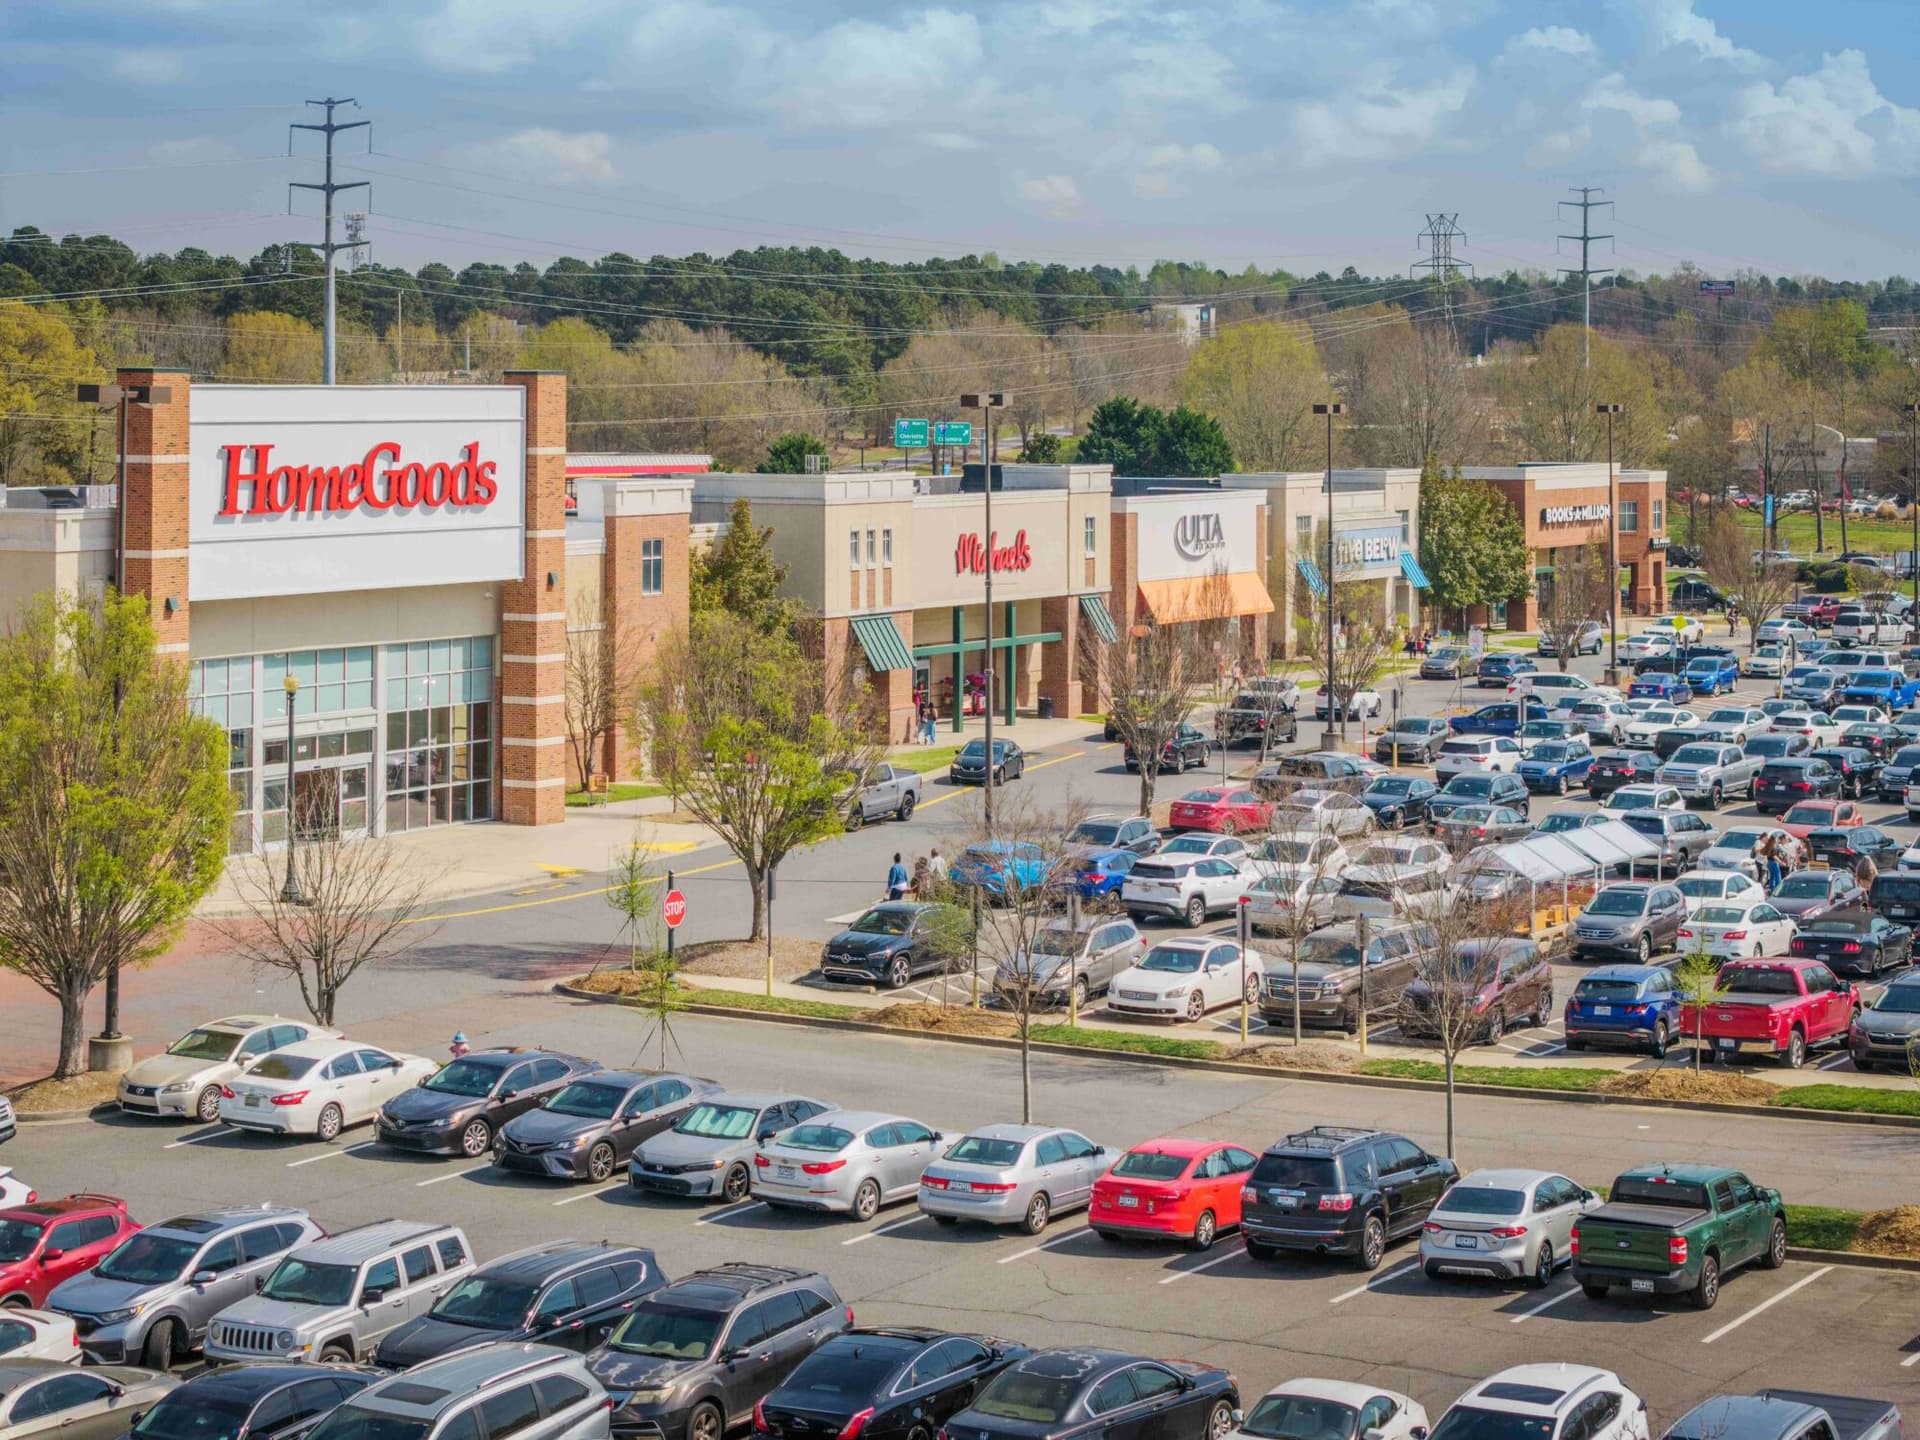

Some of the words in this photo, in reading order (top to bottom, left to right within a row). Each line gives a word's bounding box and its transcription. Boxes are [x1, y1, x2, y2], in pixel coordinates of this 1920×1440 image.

[218, 441, 498, 516] HomeGoods
[1181, 513, 1224, 545] ULTA
[955, 529, 1032, 575] Michaels
[1363, 535, 1400, 562] BELOW
[665, 901, 684, 916] STOP
